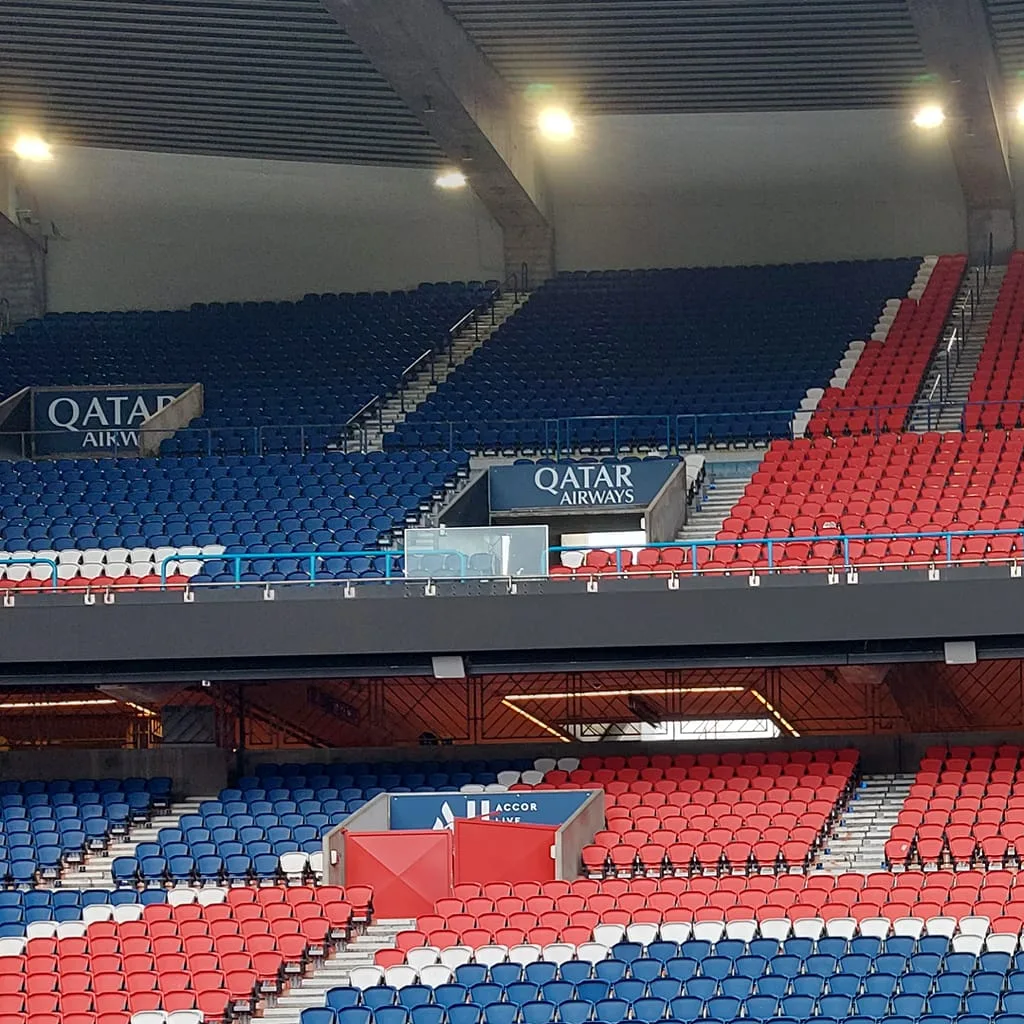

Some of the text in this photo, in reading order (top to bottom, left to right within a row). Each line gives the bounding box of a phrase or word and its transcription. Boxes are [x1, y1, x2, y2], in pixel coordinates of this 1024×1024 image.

[534, 464, 634, 495] QATAR
[560, 488, 634, 505] AIRWAYS
[495, 802, 538, 812] ACCOR
